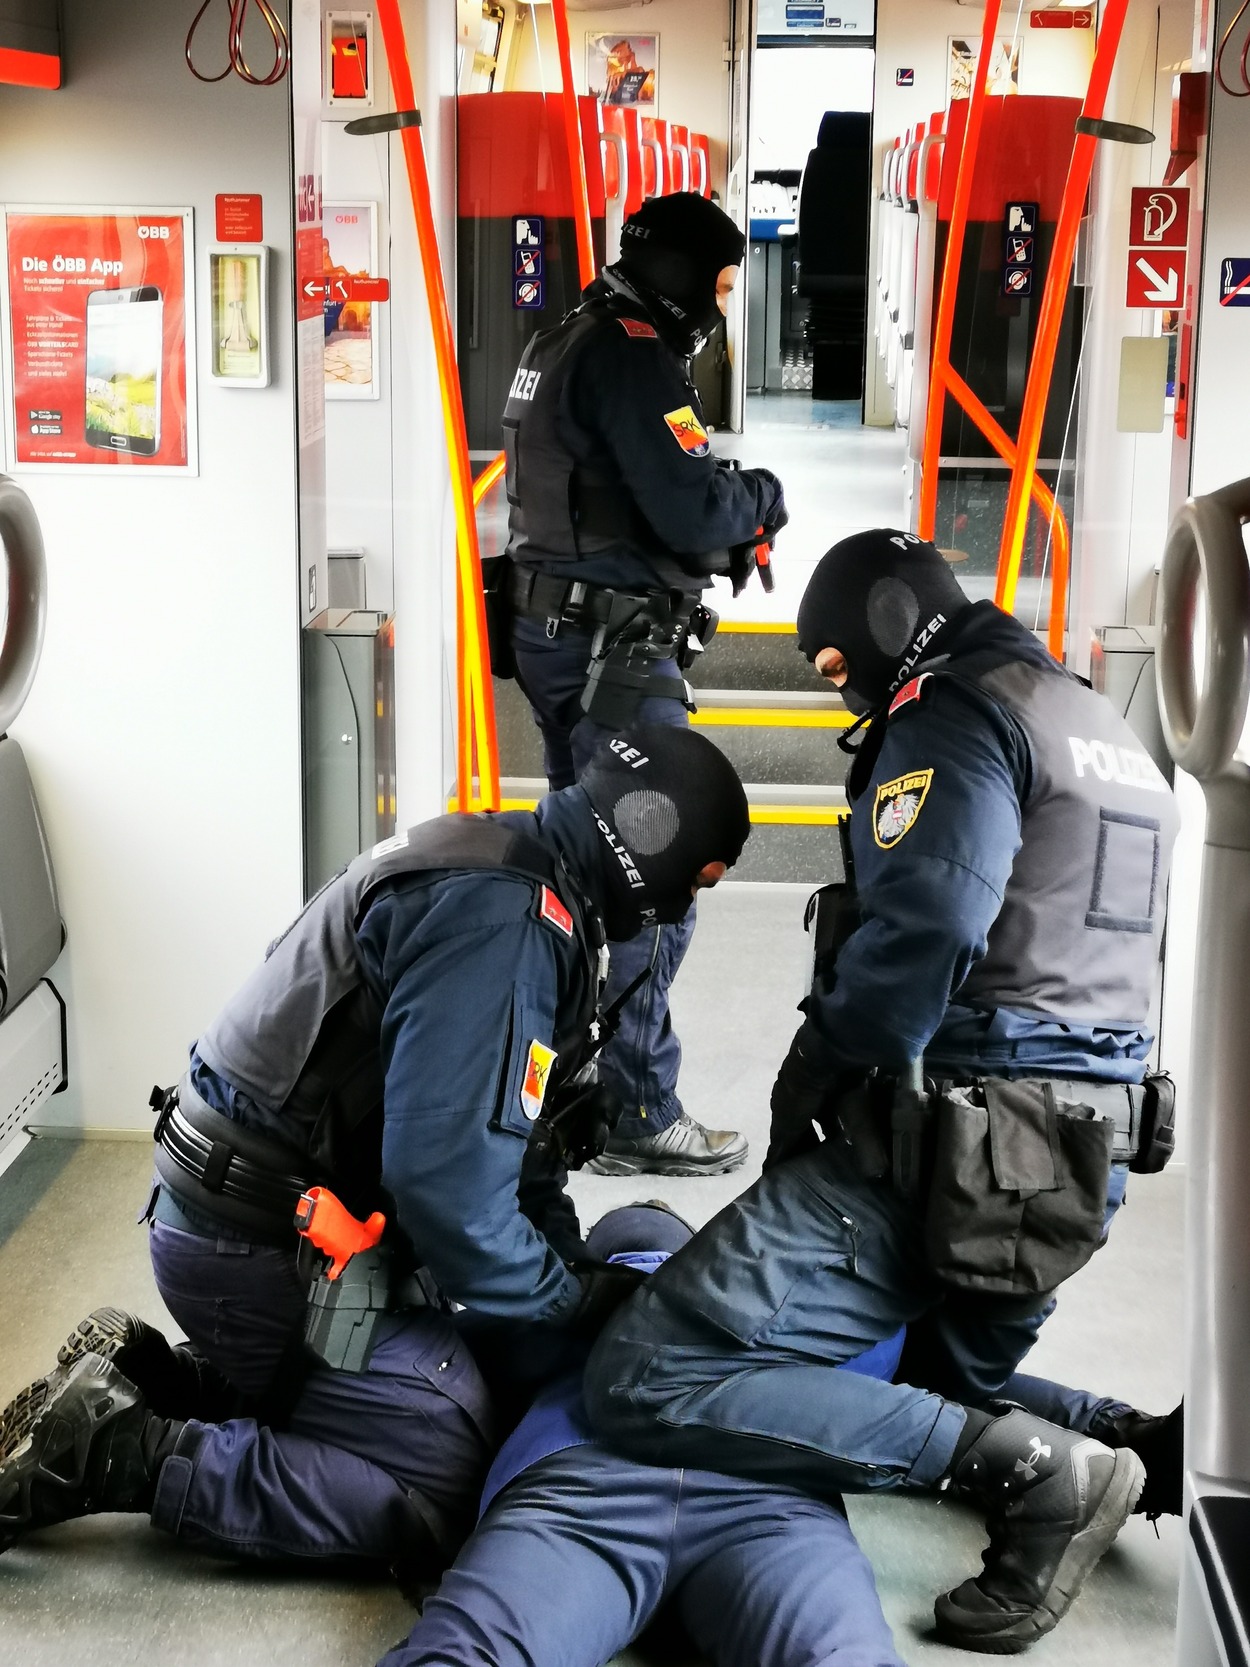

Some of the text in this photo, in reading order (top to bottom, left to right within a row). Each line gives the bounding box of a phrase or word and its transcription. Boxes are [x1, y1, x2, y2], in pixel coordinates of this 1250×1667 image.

[137, 225, 170, 239] ÖBB
[22, 255, 124, 276] Die ÖBB App
[689, 328, 706, 348] PO
[673, 417, 701, 438] SRK
[880, 775, 928, 801] POLIZEI
[591, 808, 646, 889] OLIZEI
[640, 907, 657, 926] PO
[531, 1061, 548, 1087] RK
